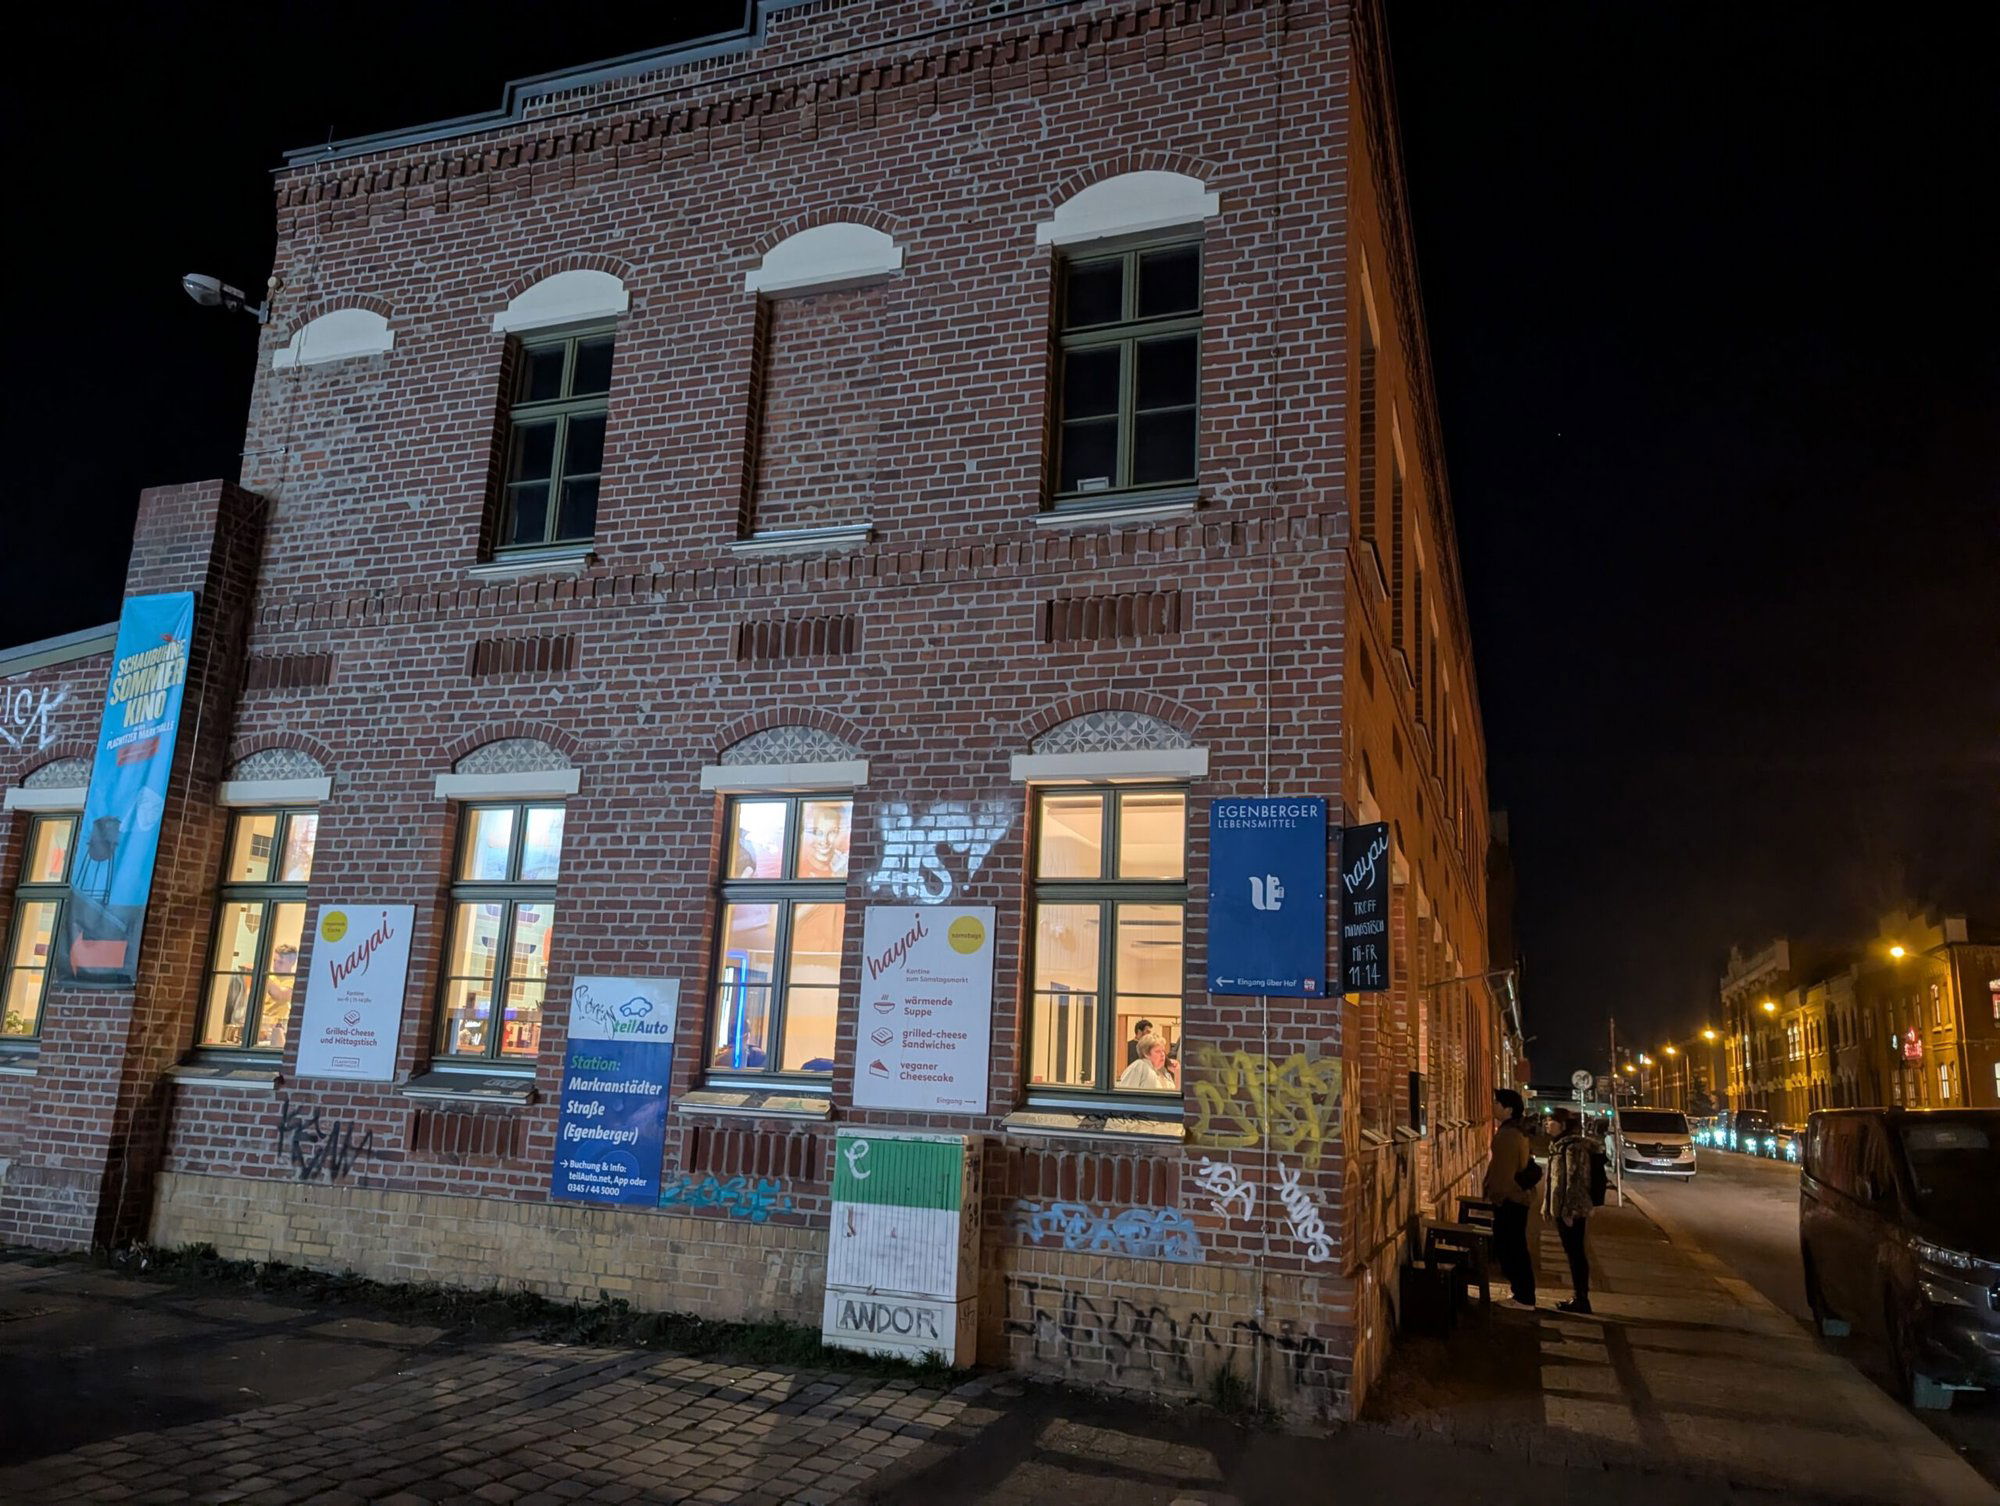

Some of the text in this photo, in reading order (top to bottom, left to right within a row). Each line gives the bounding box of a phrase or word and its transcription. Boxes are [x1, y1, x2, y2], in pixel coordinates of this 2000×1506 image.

[109, 658, 186, 705] SOMMER
[123, 691, 167, 728] KINO
[1218, 805, 1318, 818] EGENBERGER
[1218, 819, 1297, 829] LEBENSMITTEL
[1342, 827, 1389, 894] hayai
[330, 911, 394, 989] hayai
[866, 912, 929, 981] hayai
[920, 976, 969, 984] Samstagsmarkt
[1237, 977, 1266, 988] Eingang
[1266, 979, 1282, 987] über
[1283, 979, 1297, 987] Hof
[905, 996, 953, 1006] wärmende
[904, 1007, 932, 1018] Suppe
[325, 1027, 375, 1037] Grilled-Cheese
[613, 1019, 669, 1035] teilAuto
[903, 1028, 968, 1040] grilled-cheese
[320, 1037, 378, 1048] und Mittagstisch
[902, 1039, 956, 1050] Sandwiches
[571, 1055, 621, 1071] Station:
[900, 1062, 938, 1072] veganer
[899, 1071, 954, 1083] Cheesecake
[569, 1077, 662, 1095] Markranstädter
[566, 1100, 606, 1119] Straße
[563, 1122, 639, 1145] (Egenberger)
[569, 1160, 627, 1173] Buchung & Info:
[569, 1172, 648, 1187] teilAuto.net, App oder
[567, 1183, 585, 1194] 0345
[601, 1187, 620, 1196] 5000
[839, 1300, 939, 1340] ANDOR
